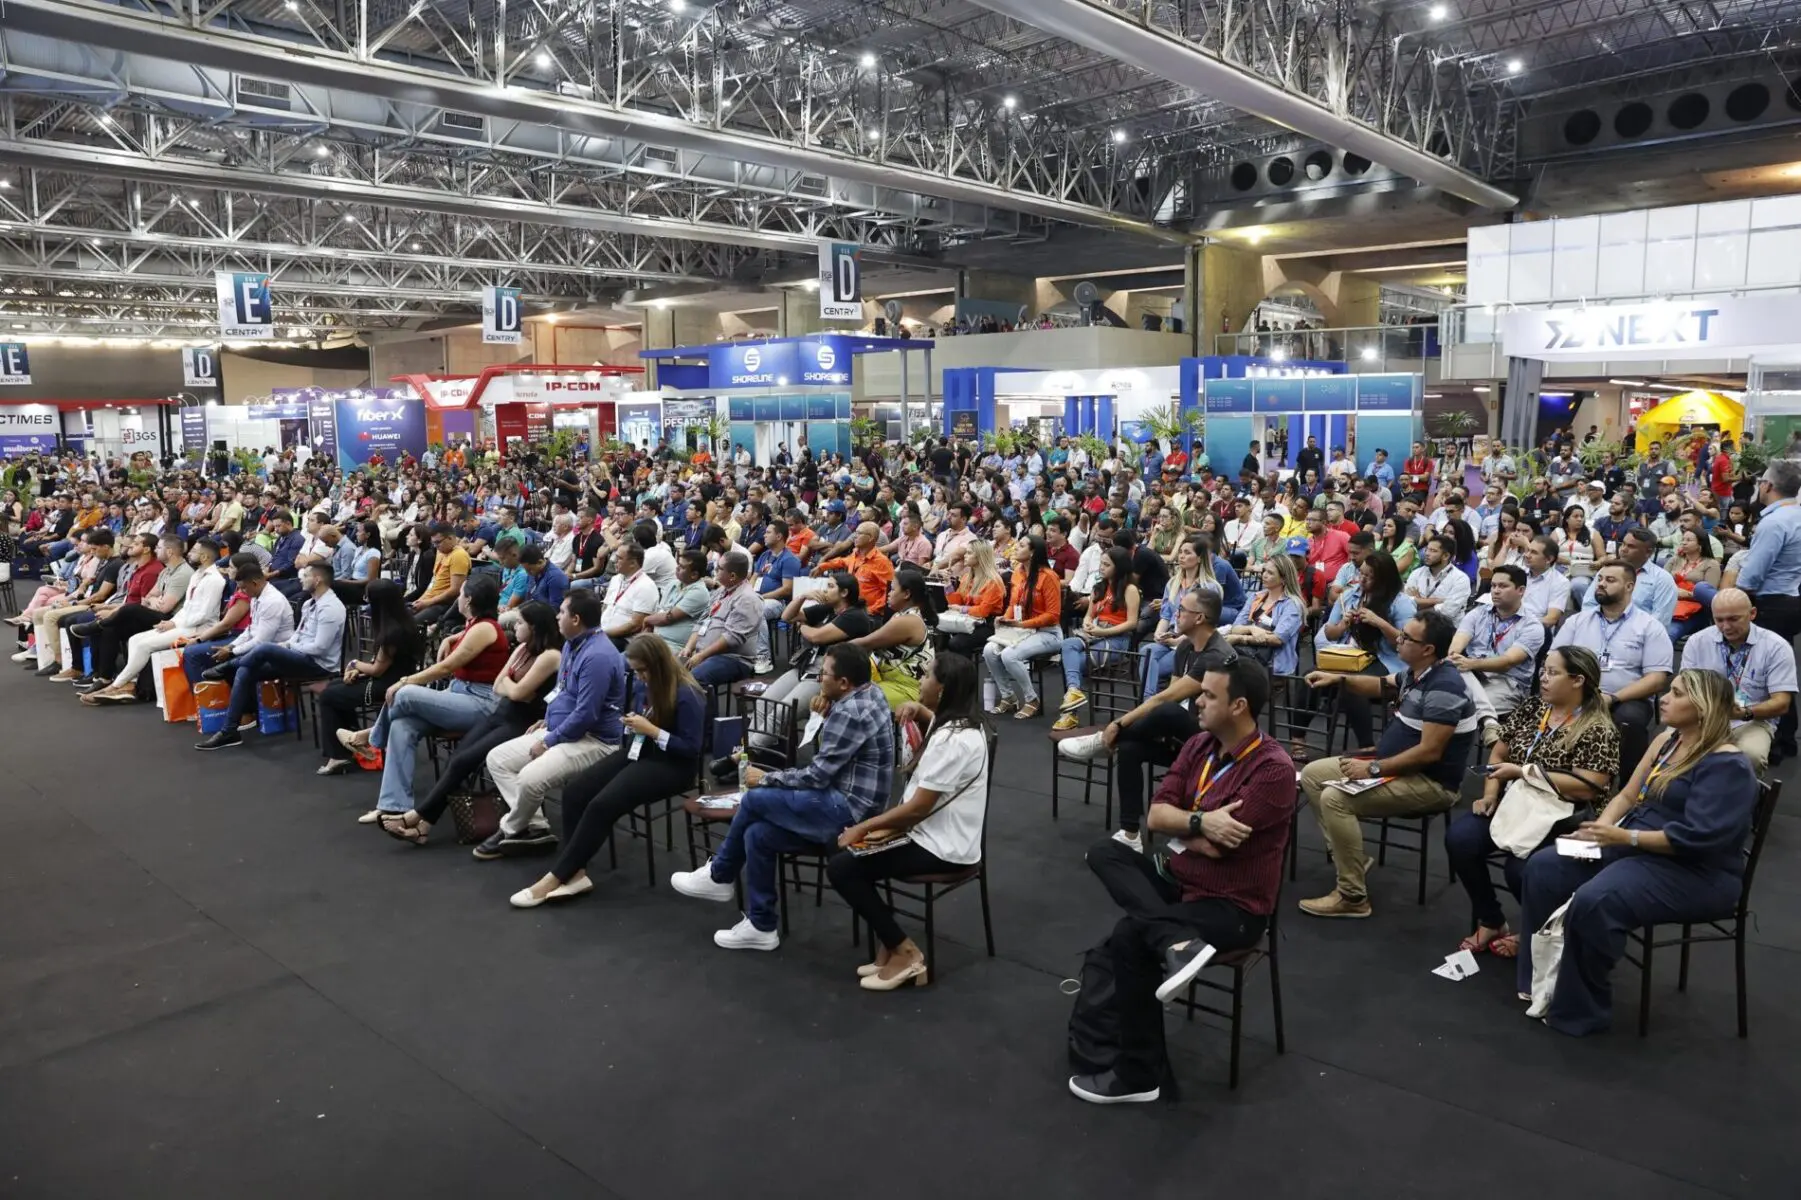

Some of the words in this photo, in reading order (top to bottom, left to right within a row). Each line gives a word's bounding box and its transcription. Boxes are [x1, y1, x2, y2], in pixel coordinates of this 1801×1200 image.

[839, 254, 855, 300] D
[242, 282, 262, 323] E
[502, 296, 517, 330] D
[824, 307, 854, 316] CENTRY
[225, 328, 263, 336] CENTRY
[1598, 308, 1719, 347] NEXT
[486, 334, 515, 342] CENTRY
[7, 348, 23, 374] E
[198, 354, 211, 377] D
[545, 381, 601, 391] IP-COM
[731, 374, 774, 384] SHORELINE
[136, 431, 157, 441] 3GS
